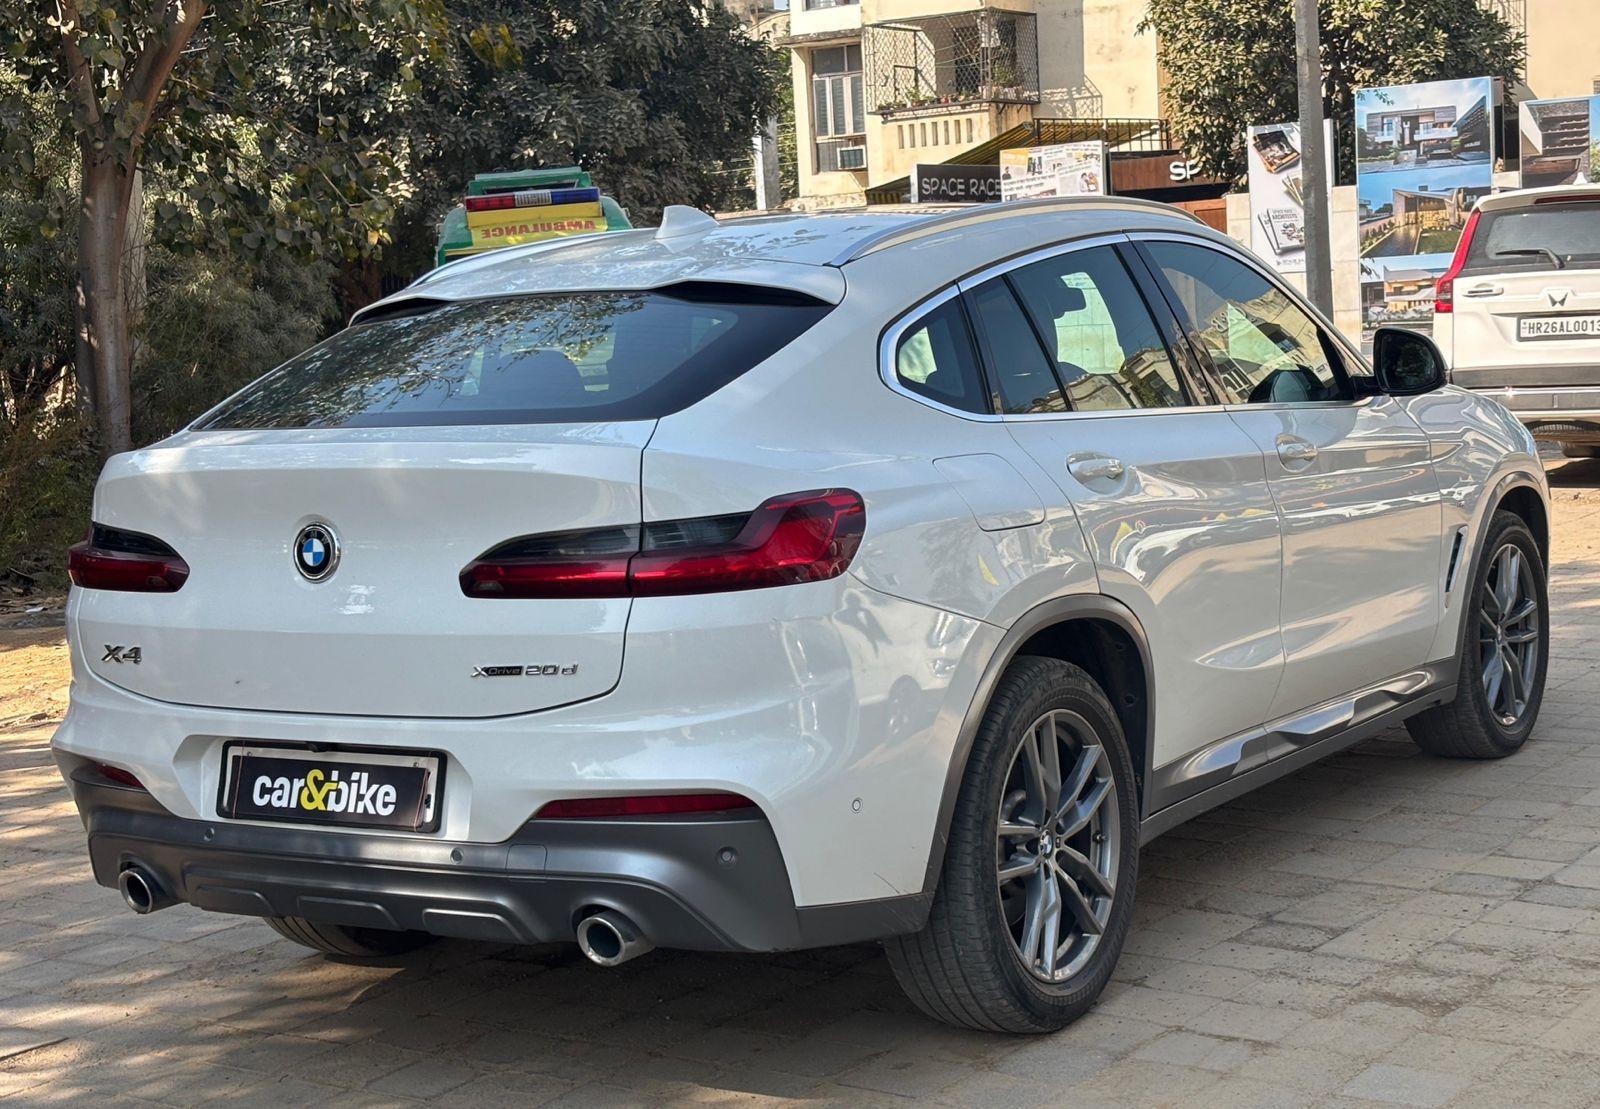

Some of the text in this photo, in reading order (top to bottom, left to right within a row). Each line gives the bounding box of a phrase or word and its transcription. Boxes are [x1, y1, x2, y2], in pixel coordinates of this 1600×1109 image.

[921, 177, 965, 196] SPACE
[969, 178, 1001, 196] RACE
[101, 644, 142, 664] X4
[252, 768, 397, 816] car&bike
